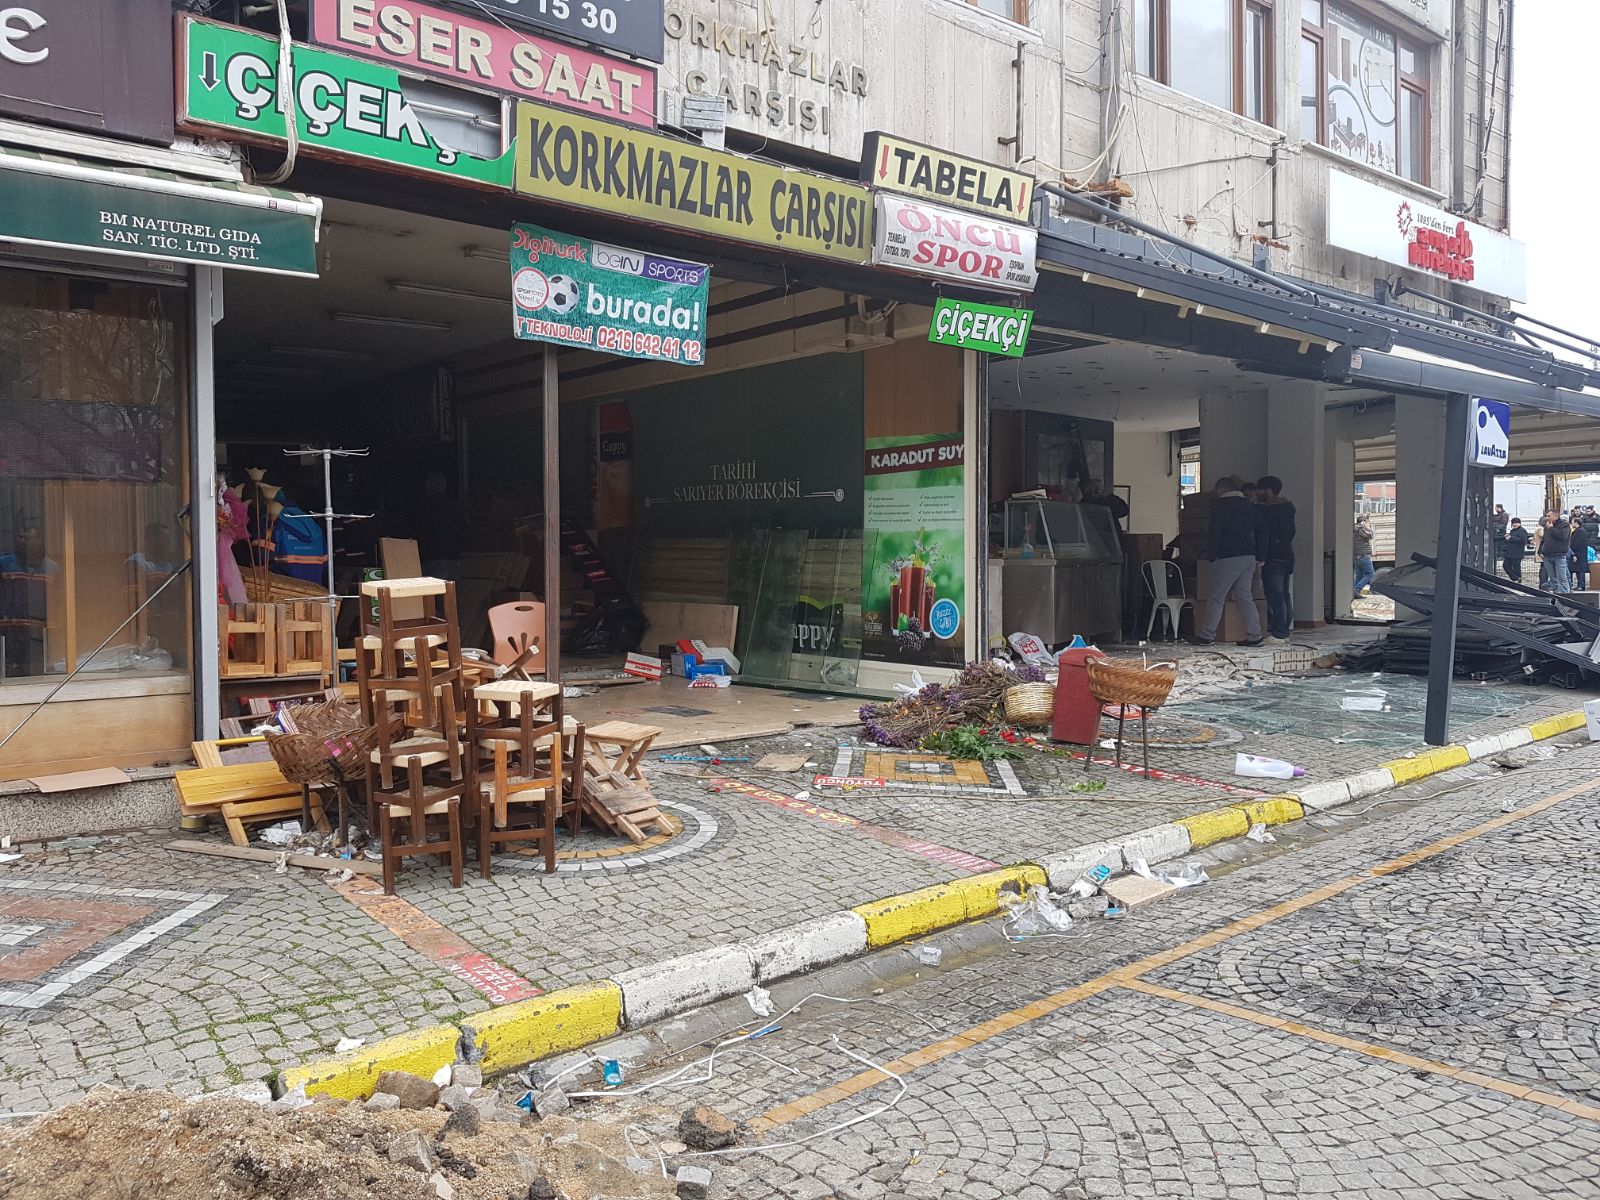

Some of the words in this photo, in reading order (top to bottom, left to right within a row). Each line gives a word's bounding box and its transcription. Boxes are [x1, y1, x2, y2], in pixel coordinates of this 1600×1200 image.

[581, 2, 617, 34] 30
[338, 0, 494, 79] ESER
[511, 42, 642, 114] SAAT
[664, 13, 867, 97] ORKMAZLAR
[530, 117, 754, 226] KORKMAZLAR
[770, 178, 866, 250] ÇARŞISI
[894, 147, 1013, 212] TABELA
[99, 211, 128, 226] BM
[133, 215, 215, 238] NATUREL
[219, 228, 262, 245] GIDA
[102, 229, 144, 246] SAN.
[147, 233, 182, 250] TİC.
[186, 239, 225, 256] LTD.
[228, 243, 259, 260] ŞTİ.
[896, 203, 1022, 255] ÖNCÜ
[648, 262, 699, 284] SPORTS
[912, 239, 1004, 278] SPOR
[587, 282, 700, 332] burada!
[526, 318, 592, 344] TEKNOLOJİ
[597, 325, 631, 350] 0216
[634, 333, 660, 356] 642
[662, 338, 680, 358] 41
[682, 340, 701, 361] 12
[936, 303, 1028, 352] ÇİÇEKÇİ
[710, 458, 756, 481] TARİHİ
[871, 447, 935, 469] KARADUT
[938, 443, 965, 461] SUY
[1481, 443, 1506, 460] LAVAZZA
[673, 484, 724, 502] SARIYER
[727, 476, 800, 504] BÖREKÇİSİ
[791, 623, 835, 650] appy
